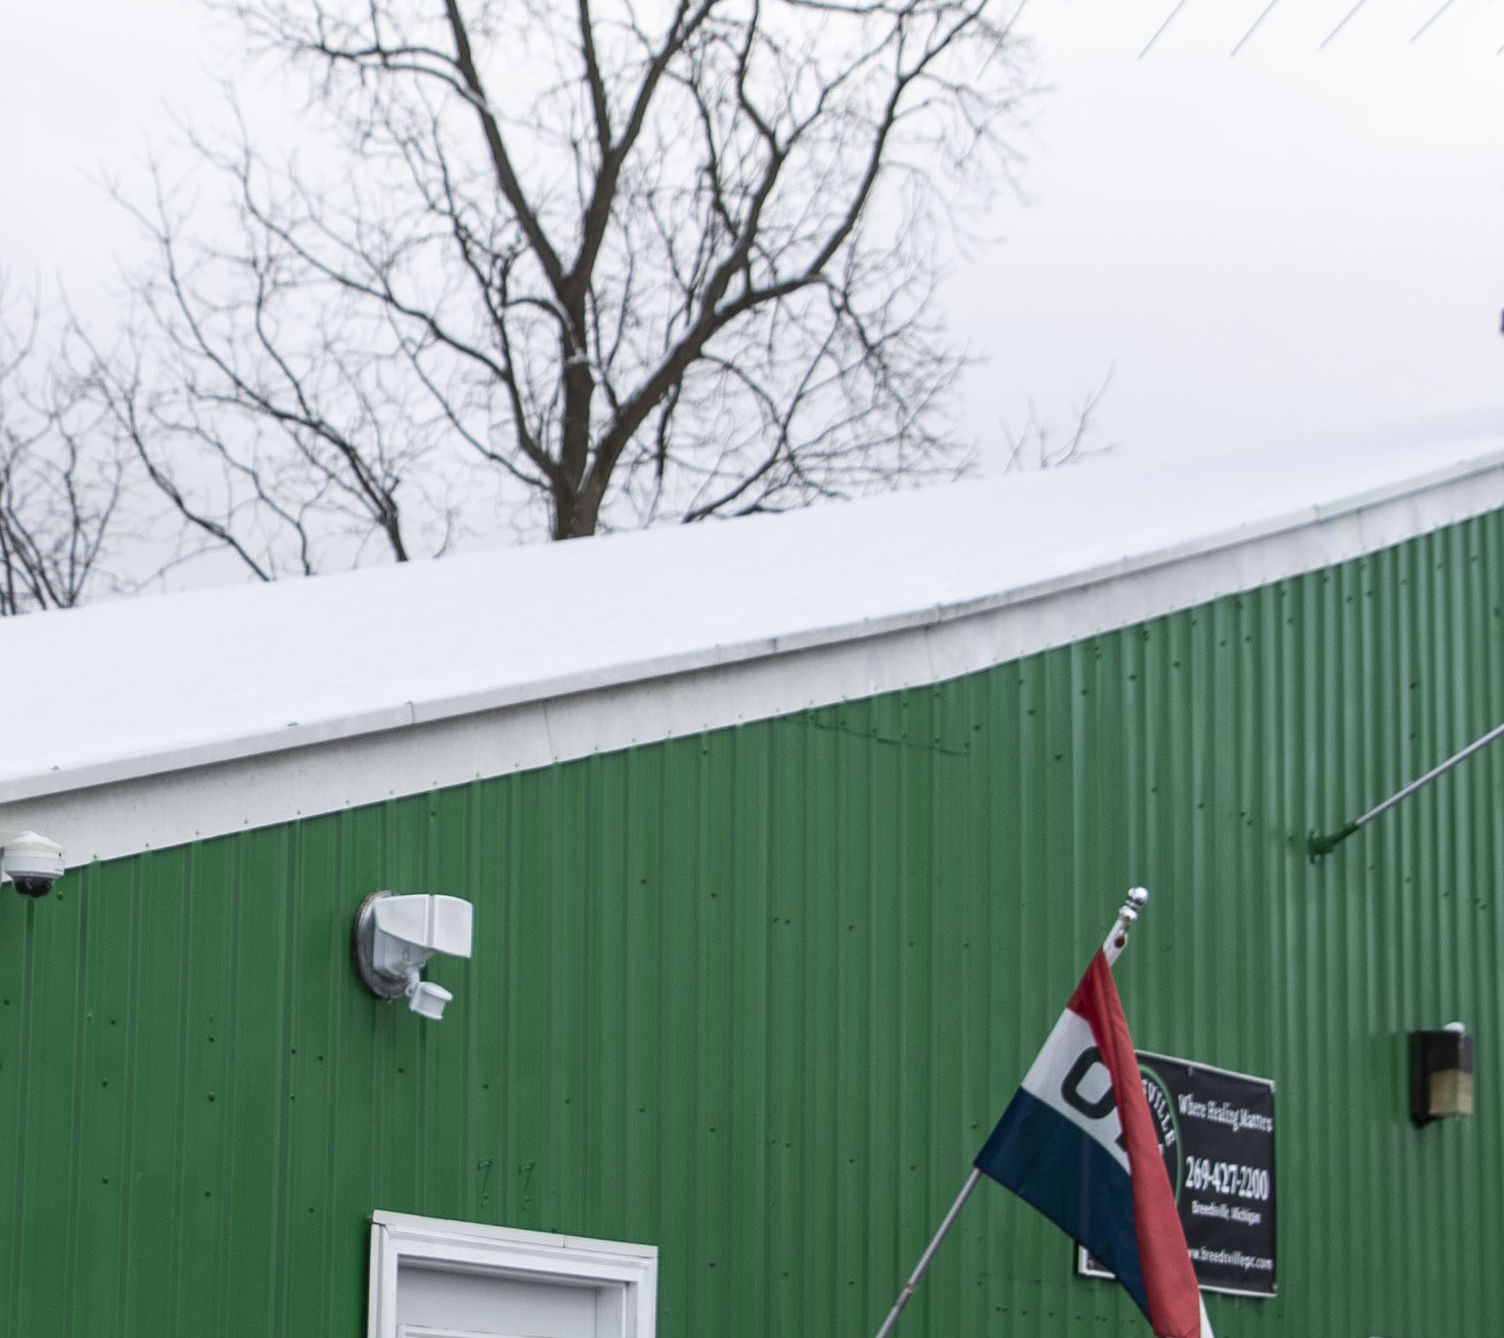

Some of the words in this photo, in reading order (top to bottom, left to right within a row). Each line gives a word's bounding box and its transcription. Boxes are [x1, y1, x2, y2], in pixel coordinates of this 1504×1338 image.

[1178, 1093, 1206, 1118] Where
[1207, 1101, 1240, 1133] Healing
[1240, 1108, 1273, 1133] Matters
[1185, 1156, 1270, 1201] 269-427-2200
